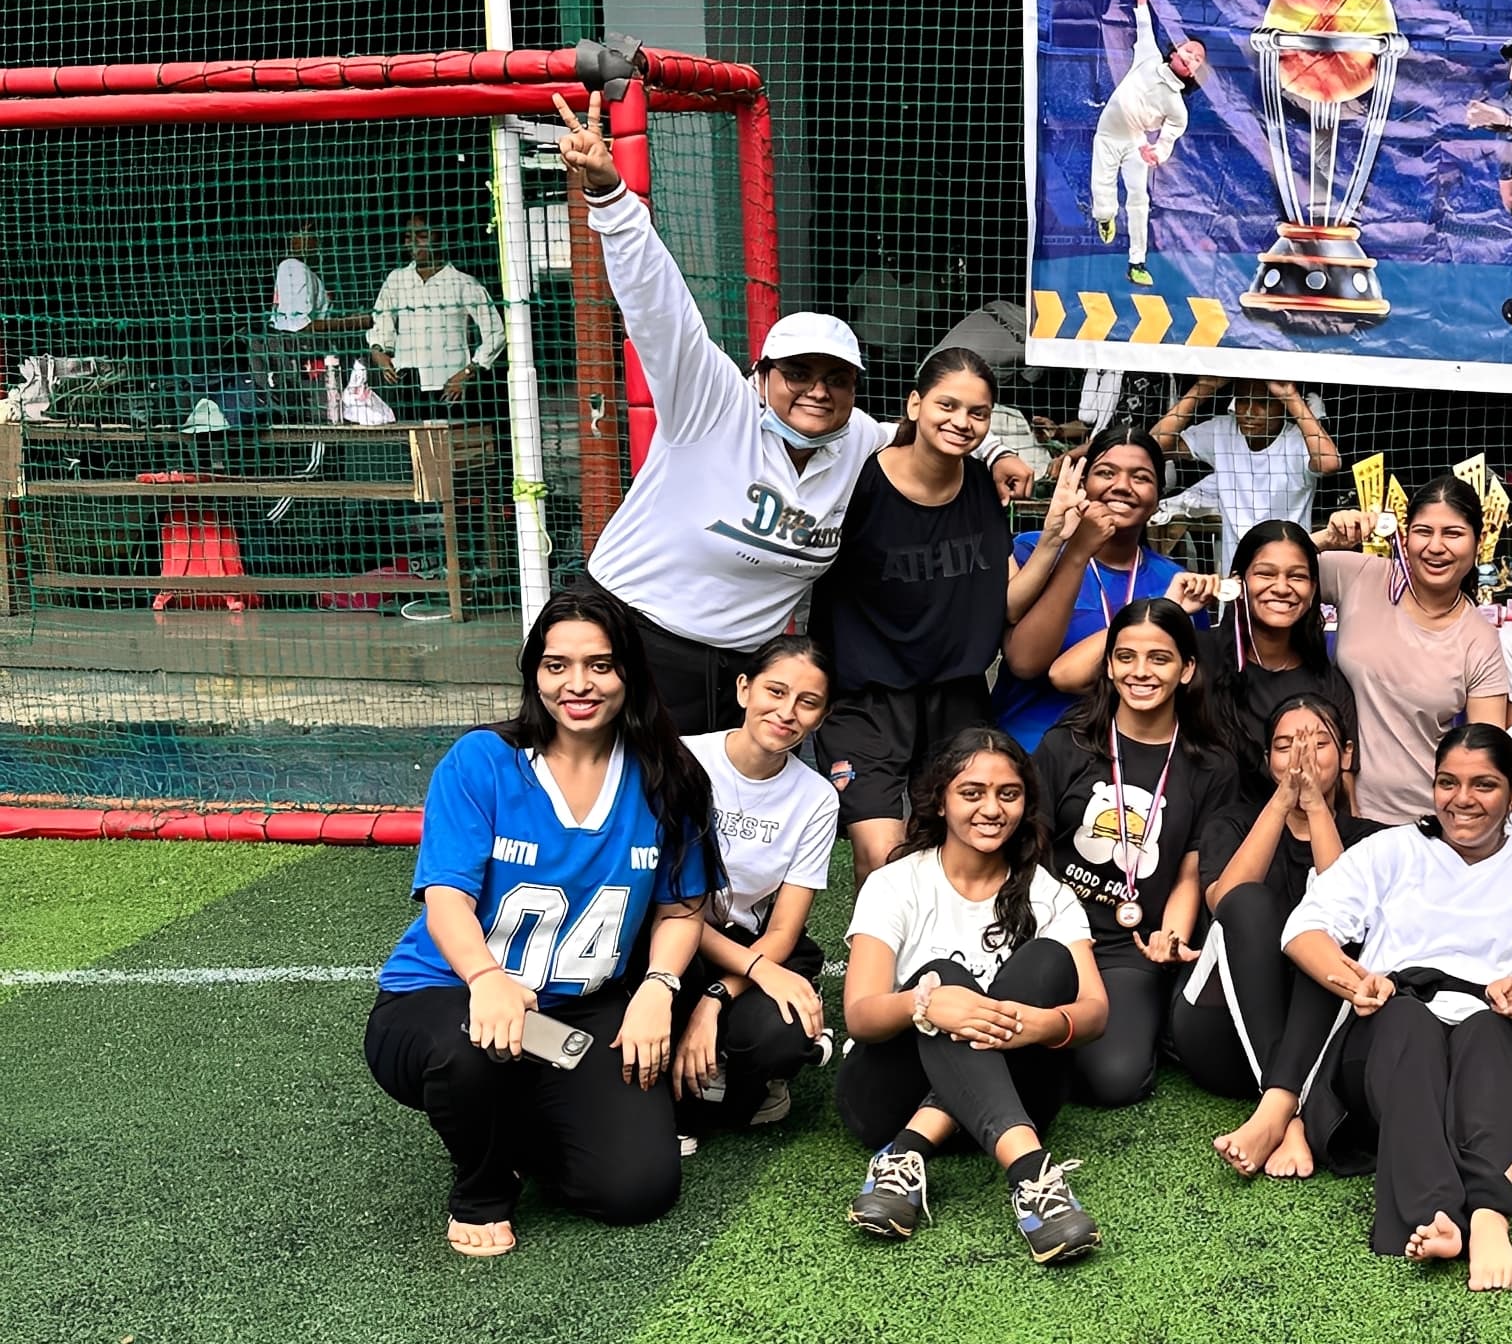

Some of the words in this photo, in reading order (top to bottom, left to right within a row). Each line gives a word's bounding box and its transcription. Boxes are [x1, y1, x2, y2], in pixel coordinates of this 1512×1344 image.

[492, 835, 539, 867] MHTN
[630, 846, 659, 870] NYC
[1065, 863, 1101, 888] GOOD
[485, 881, 631, 997] 04
